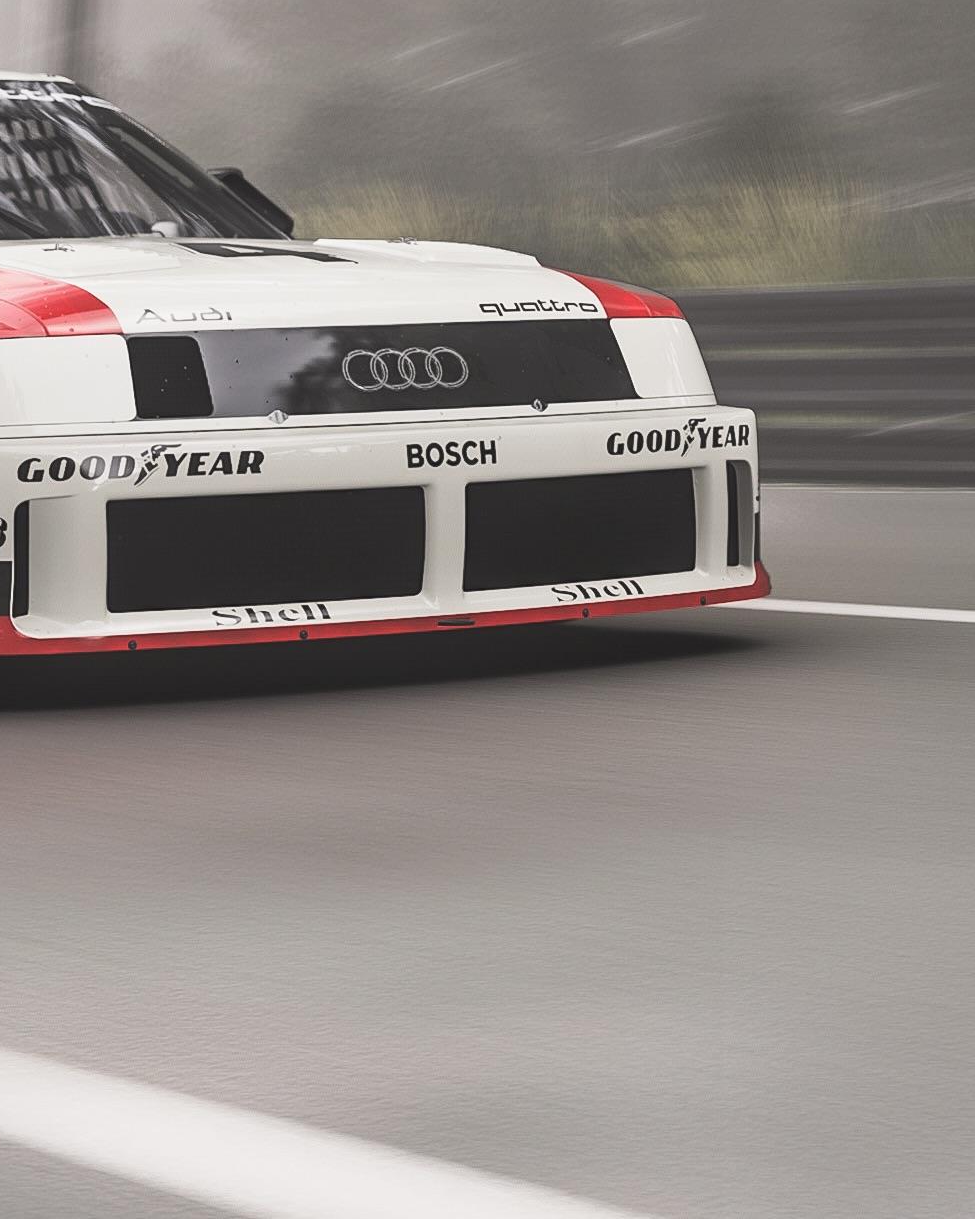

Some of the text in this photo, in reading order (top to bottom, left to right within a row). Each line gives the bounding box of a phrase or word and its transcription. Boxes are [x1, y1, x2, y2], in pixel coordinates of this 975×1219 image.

[136, 306, 233, 324] Audi
[479, 299, 598, 317] quattro
[406, 439, 497, 469] BOSCH
[551, 579, 644, 602] Shell
[212, 603, 331, 626] Shell
